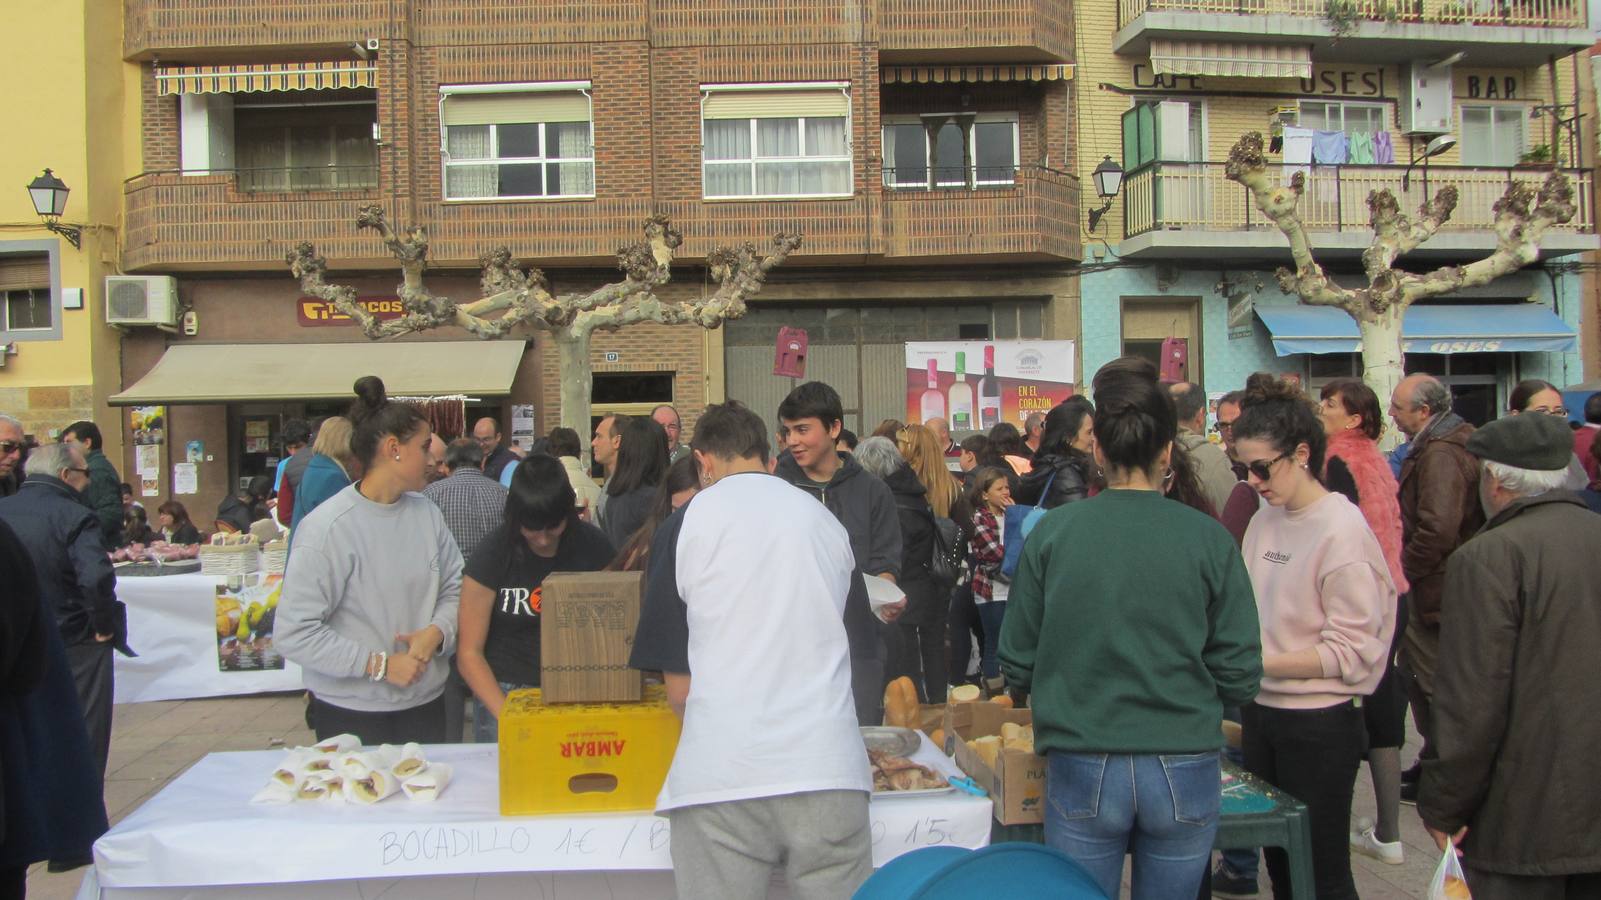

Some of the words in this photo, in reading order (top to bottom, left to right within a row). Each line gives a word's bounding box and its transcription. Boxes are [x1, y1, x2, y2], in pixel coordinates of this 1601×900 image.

[1468, 76, 1516, 99] BAR
[1018, 386, 1028, 397] EN
[1029, 386, 1037, 397] EL
[1018, 396, 1052, 410] CORAZÓN
[560, 740, 626, 759] AMBAR
[379, 827, 530, 866] BOCADILLO
